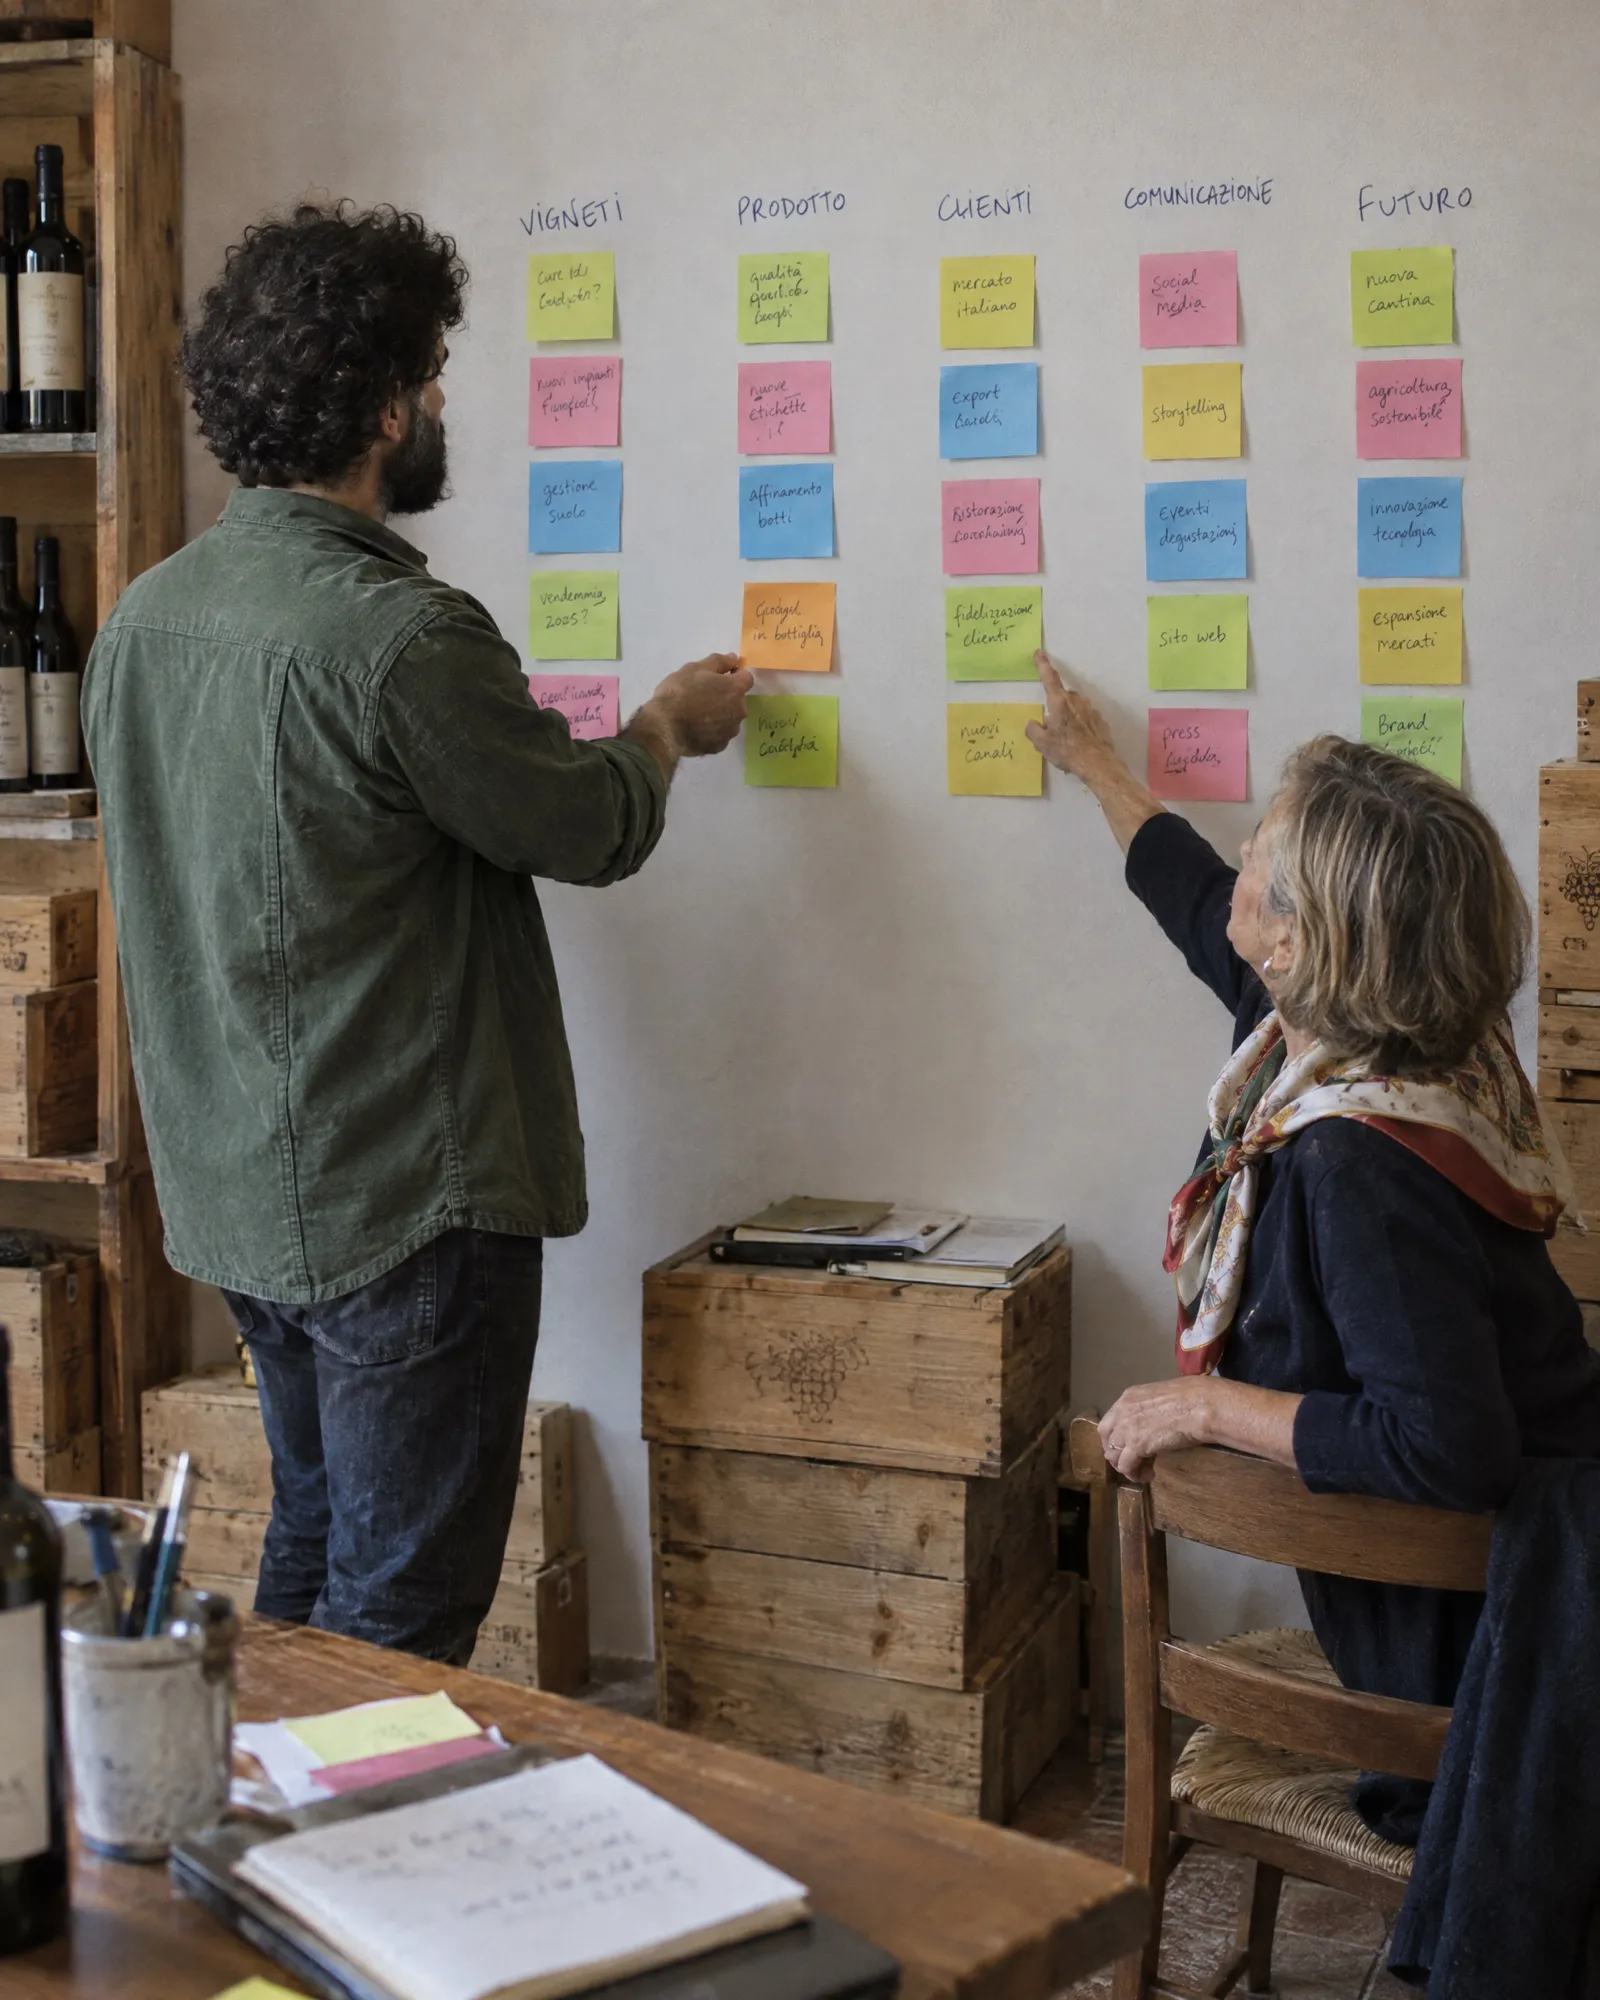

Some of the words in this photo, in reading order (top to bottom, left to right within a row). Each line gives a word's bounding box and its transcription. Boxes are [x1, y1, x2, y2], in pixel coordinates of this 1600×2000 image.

[938, 186, 1031, 221] CLIENTI
[1124, 178, 1273, 209] COMUNICAZIONE
[1358, 184, 1472, 221] FUTURO
[738, 191, 846, 225] PRODOTTO
[953, 272, 1013, 292] mercato
[957, 298, 1017, 318] italiano
[543, 479, 598, 506] gestione
[749, 481, 822, 508] affinamento
[758, 509, 793, 528] botti
[1370, 497, 1449, 517] innovazione
[1196, 624, 1226, 643] web
[1377, 631, 1438, 652] mercati
[1379, 712, 1429, 736] Brand
[1163, 726, 1200, 750] press
